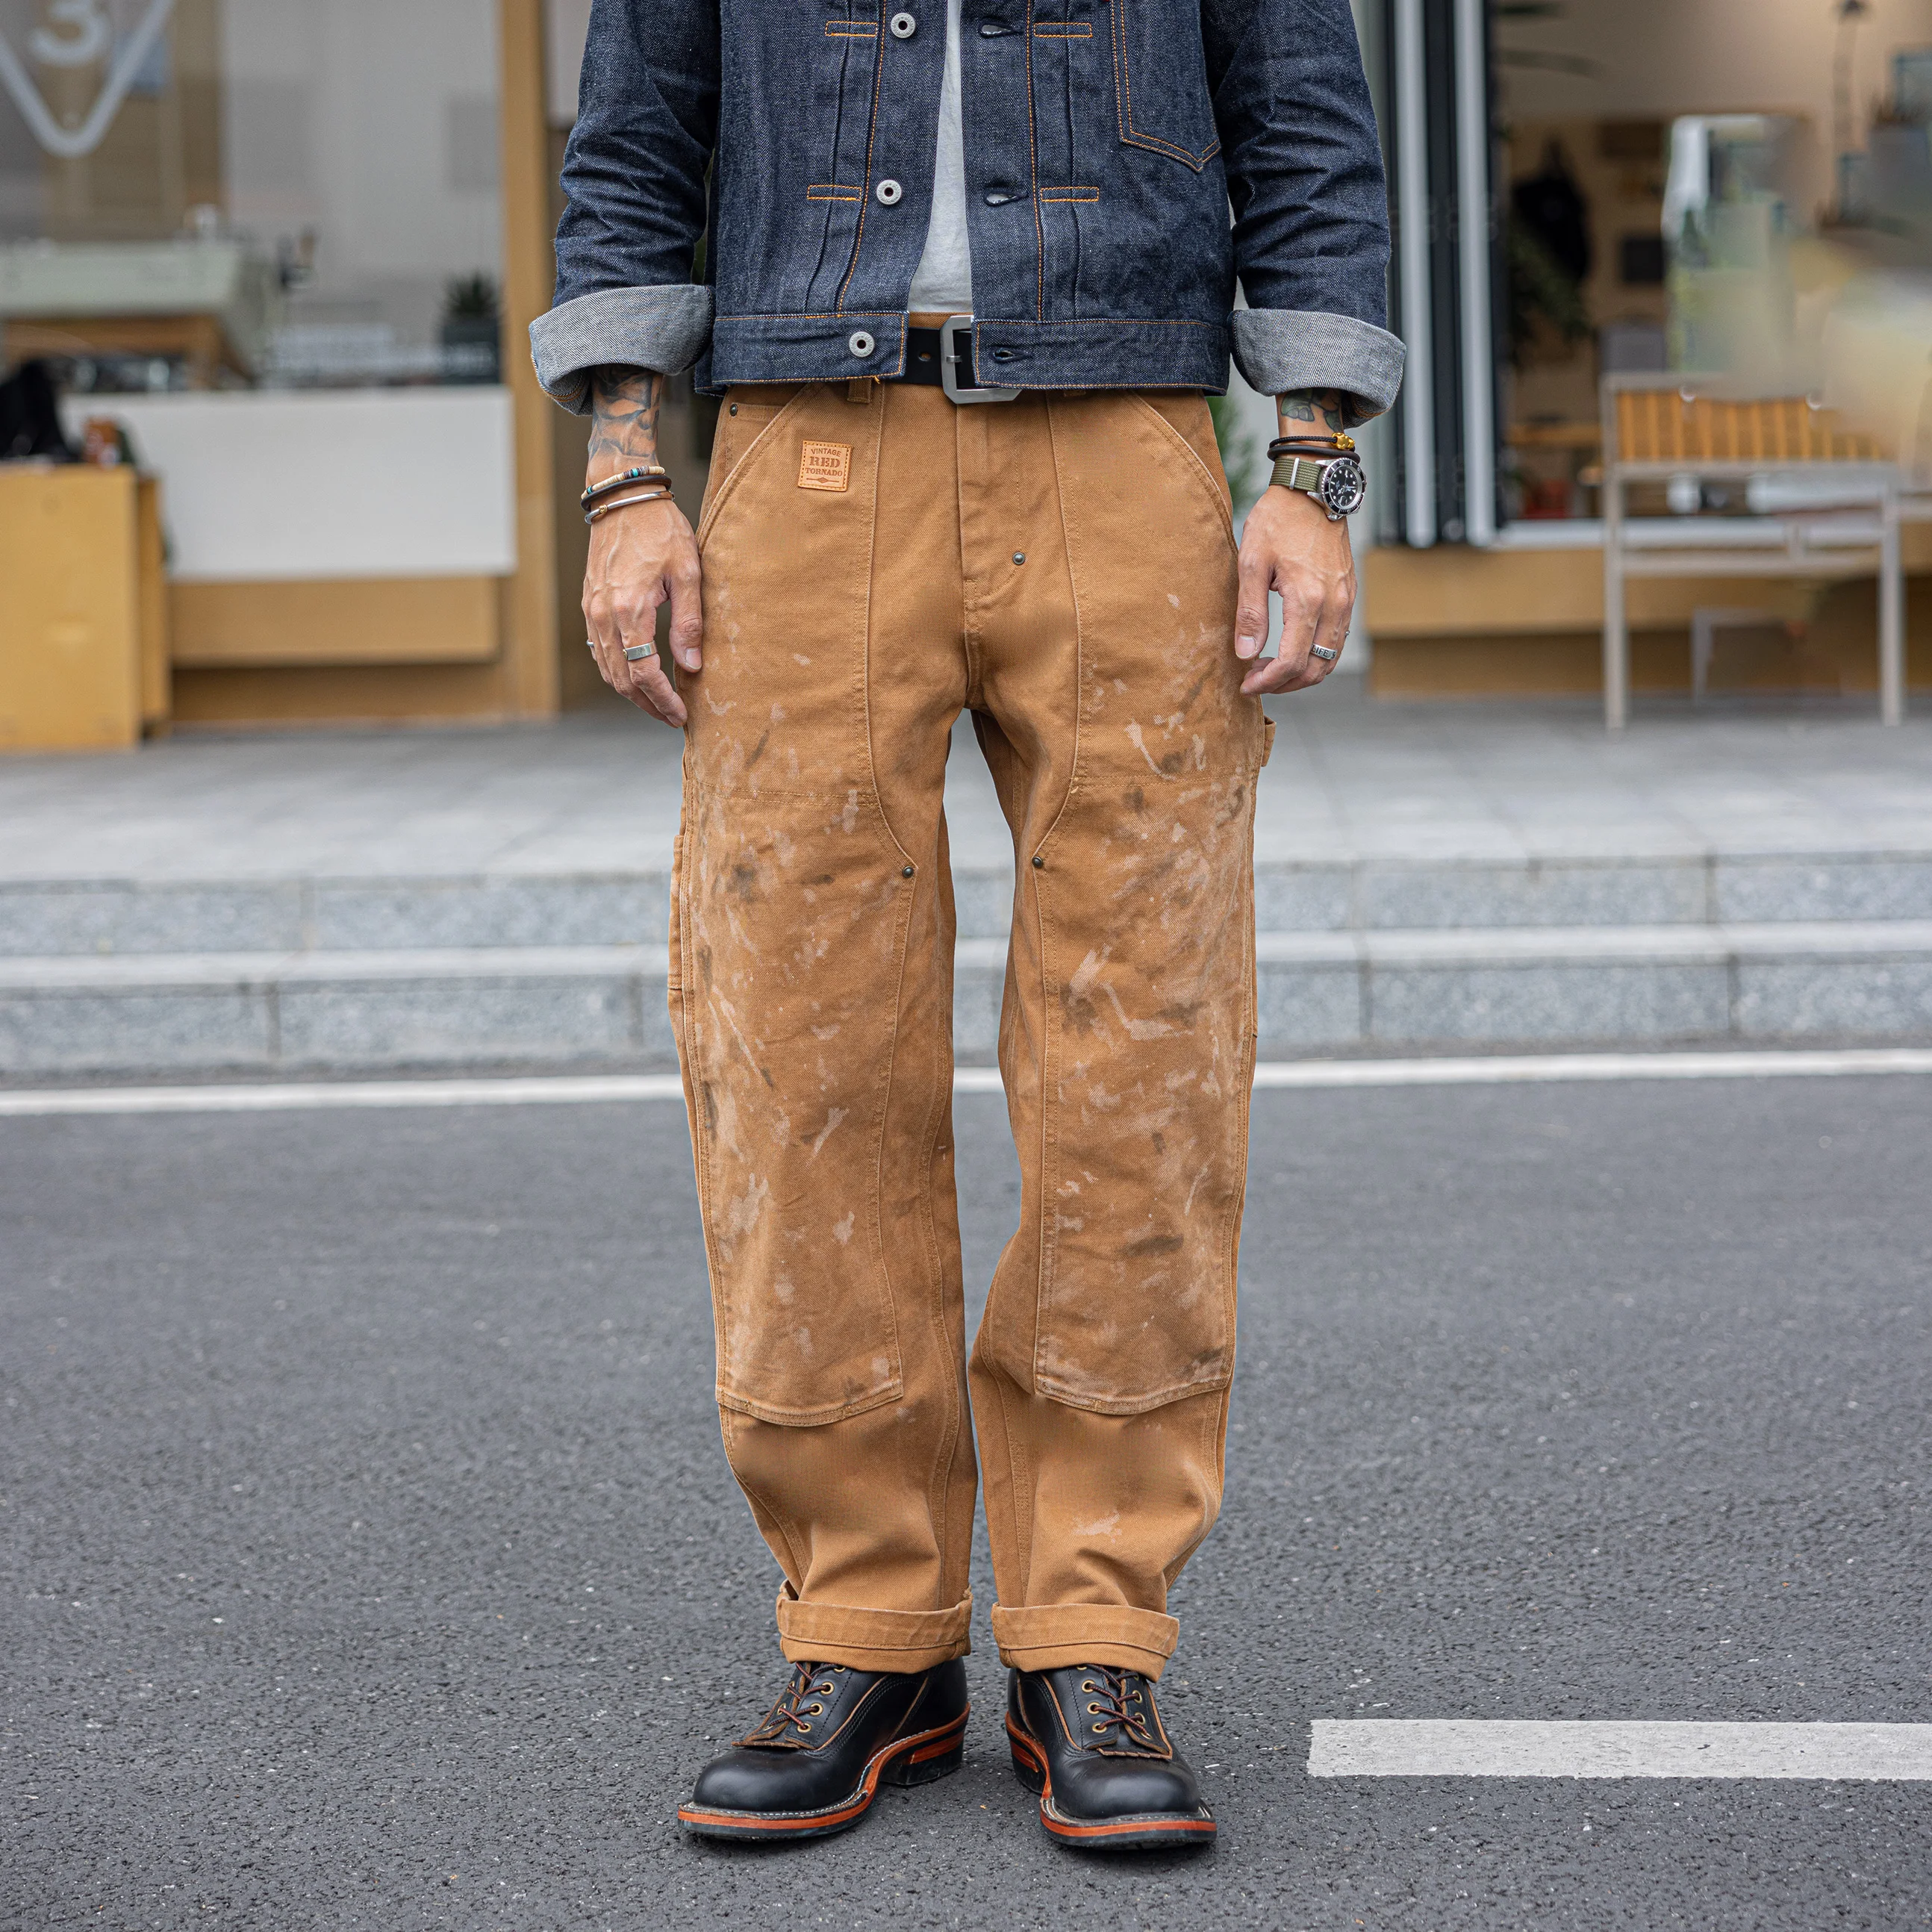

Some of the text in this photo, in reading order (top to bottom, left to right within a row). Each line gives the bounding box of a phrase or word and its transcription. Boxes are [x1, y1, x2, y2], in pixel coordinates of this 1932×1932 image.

[811, 448, 841, 457] VINTAGE
[809, 456, 841, 468] RED
[805, 467, 843, 476] TORNADO
[1312, 645, 1329, 657] LIFE
